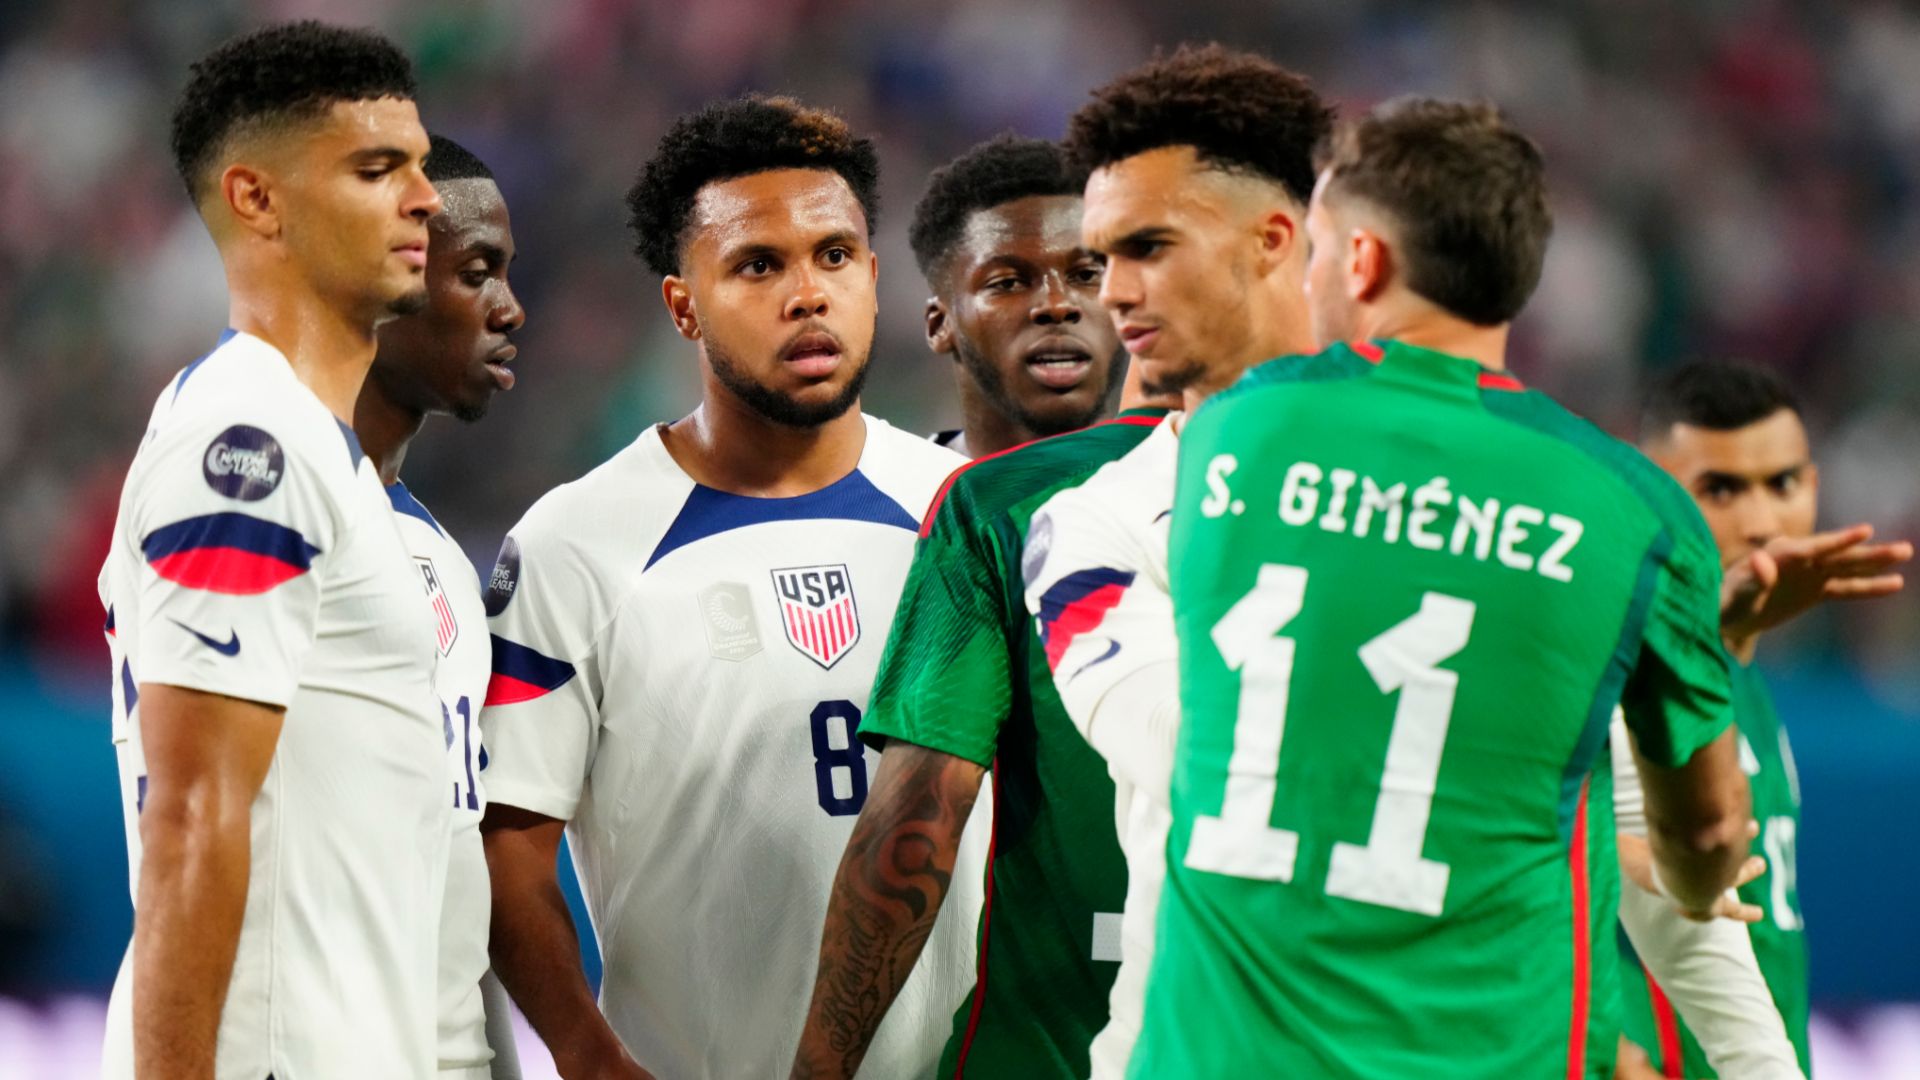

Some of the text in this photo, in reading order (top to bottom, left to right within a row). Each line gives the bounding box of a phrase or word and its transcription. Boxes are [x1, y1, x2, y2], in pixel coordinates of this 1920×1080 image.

[1200, 454, 1584, 582] S. GIMÉNEZ
[778, 571, 846, 608] USA
[440, 695, 480, 811] 1
[809, 699, 868, 816] 8
[1183, 563, 1476, 916] 11
